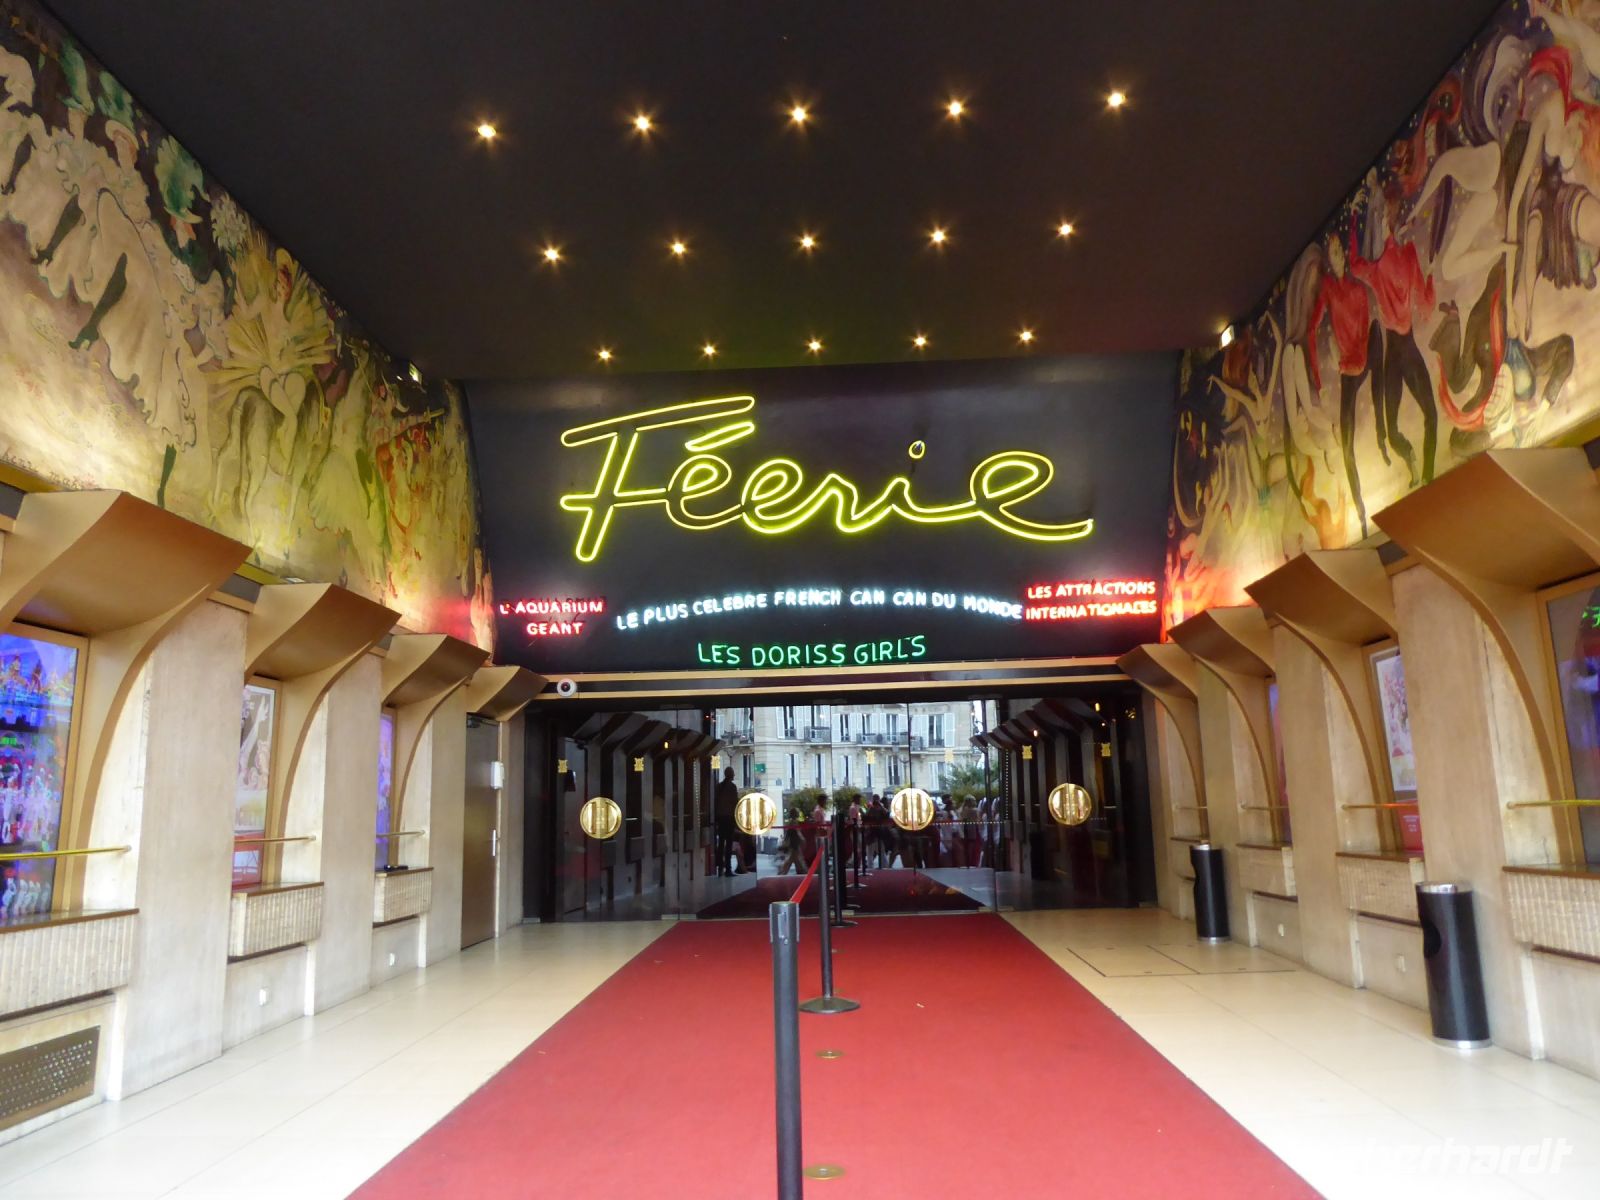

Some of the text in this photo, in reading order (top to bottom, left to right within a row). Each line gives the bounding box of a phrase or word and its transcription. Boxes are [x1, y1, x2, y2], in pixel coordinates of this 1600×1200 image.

[560, 395, 1095, 564] Féerie
[1027, 581, 1156, 599] LES ATTRACTIONS
[616, 612, 640, 631] LE
[643, 603, 688, 625] PLUS
[773, 589, 842, 606] FRENCH
[850, 590, 886, 605] CAN
[892, 591, 927, 606] CAN
[931, 592, 956, 608] DU
[963, 595, 1023, 619] MONDE
[1025, 601, 1157, 620] INTERNATIONALES
[526, 622, 584, 636] GEANT
[697, 642, 741, 665] LES
[751, 643, 847, 667] DORISS
